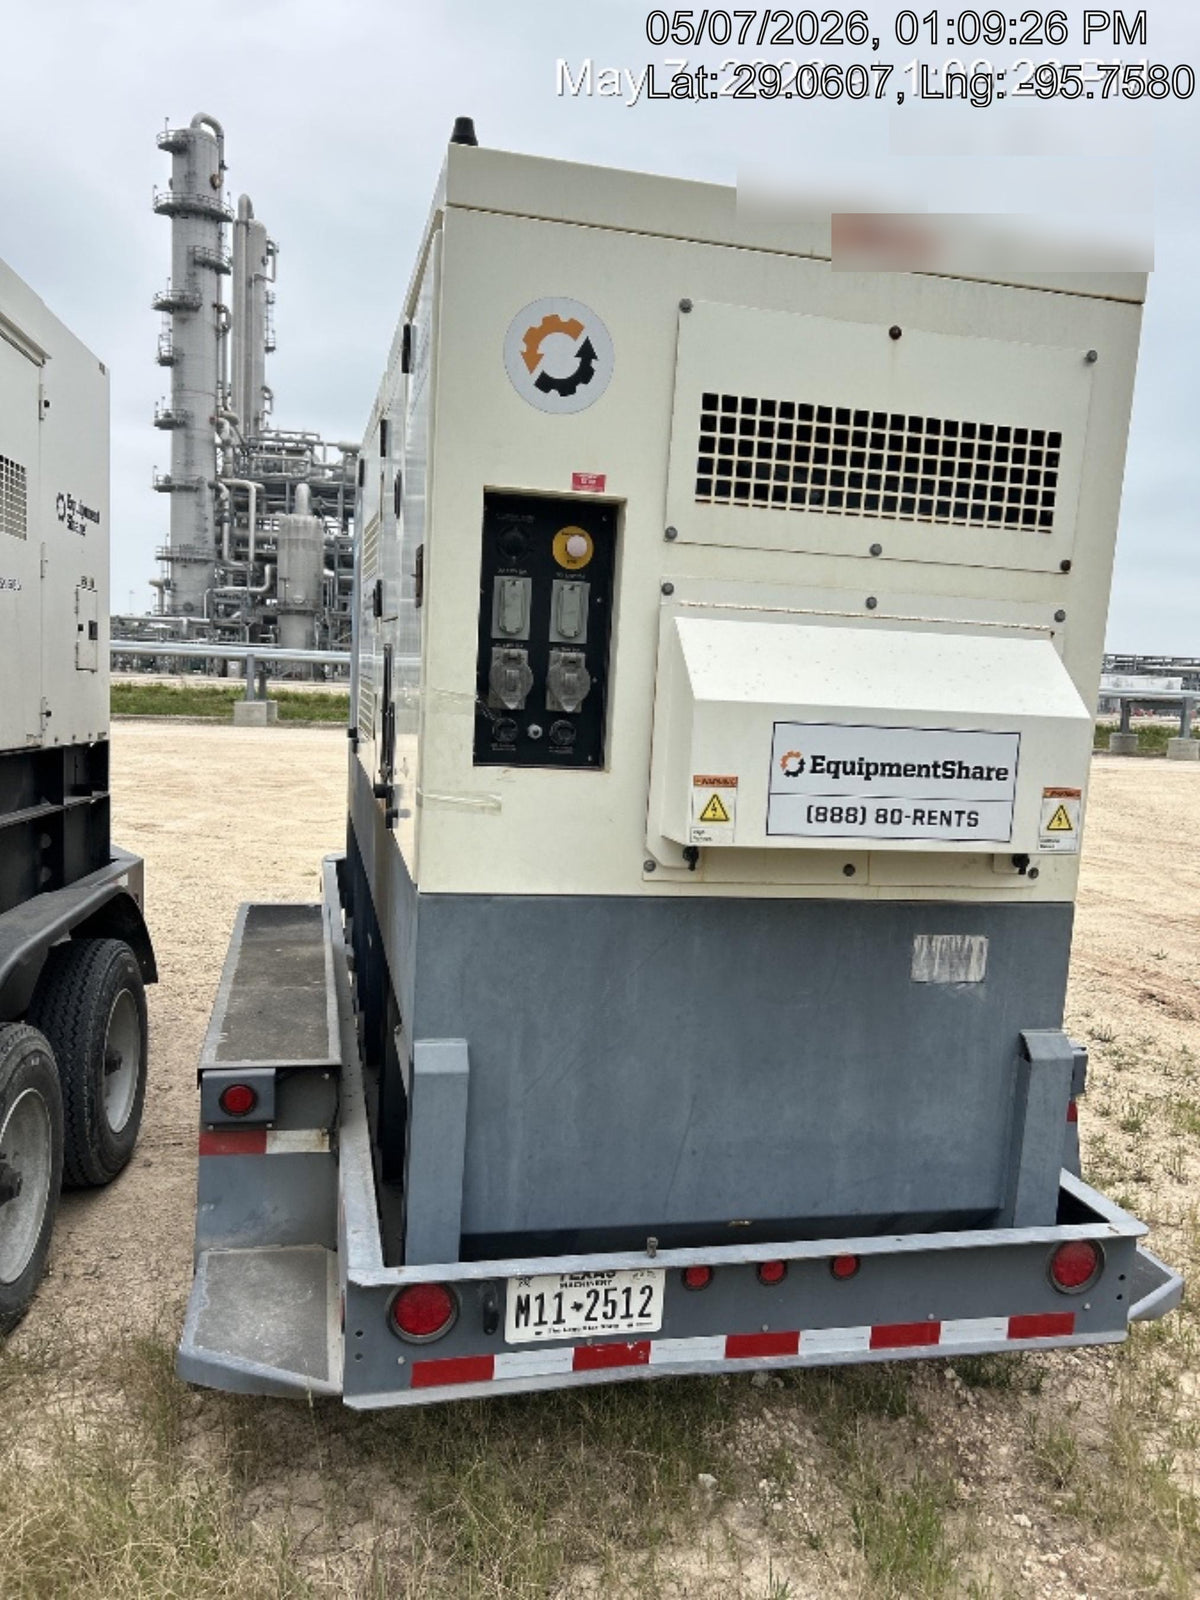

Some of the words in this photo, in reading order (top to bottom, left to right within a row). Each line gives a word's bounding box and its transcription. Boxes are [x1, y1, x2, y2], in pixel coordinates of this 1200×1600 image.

[809, 754, 1009, 782] EquipmentShare
[806, 805, 867, 825] (888)
[875, 808, 979, 828] 80-RENTS
[584, 1284, 654, 1322] 2512
